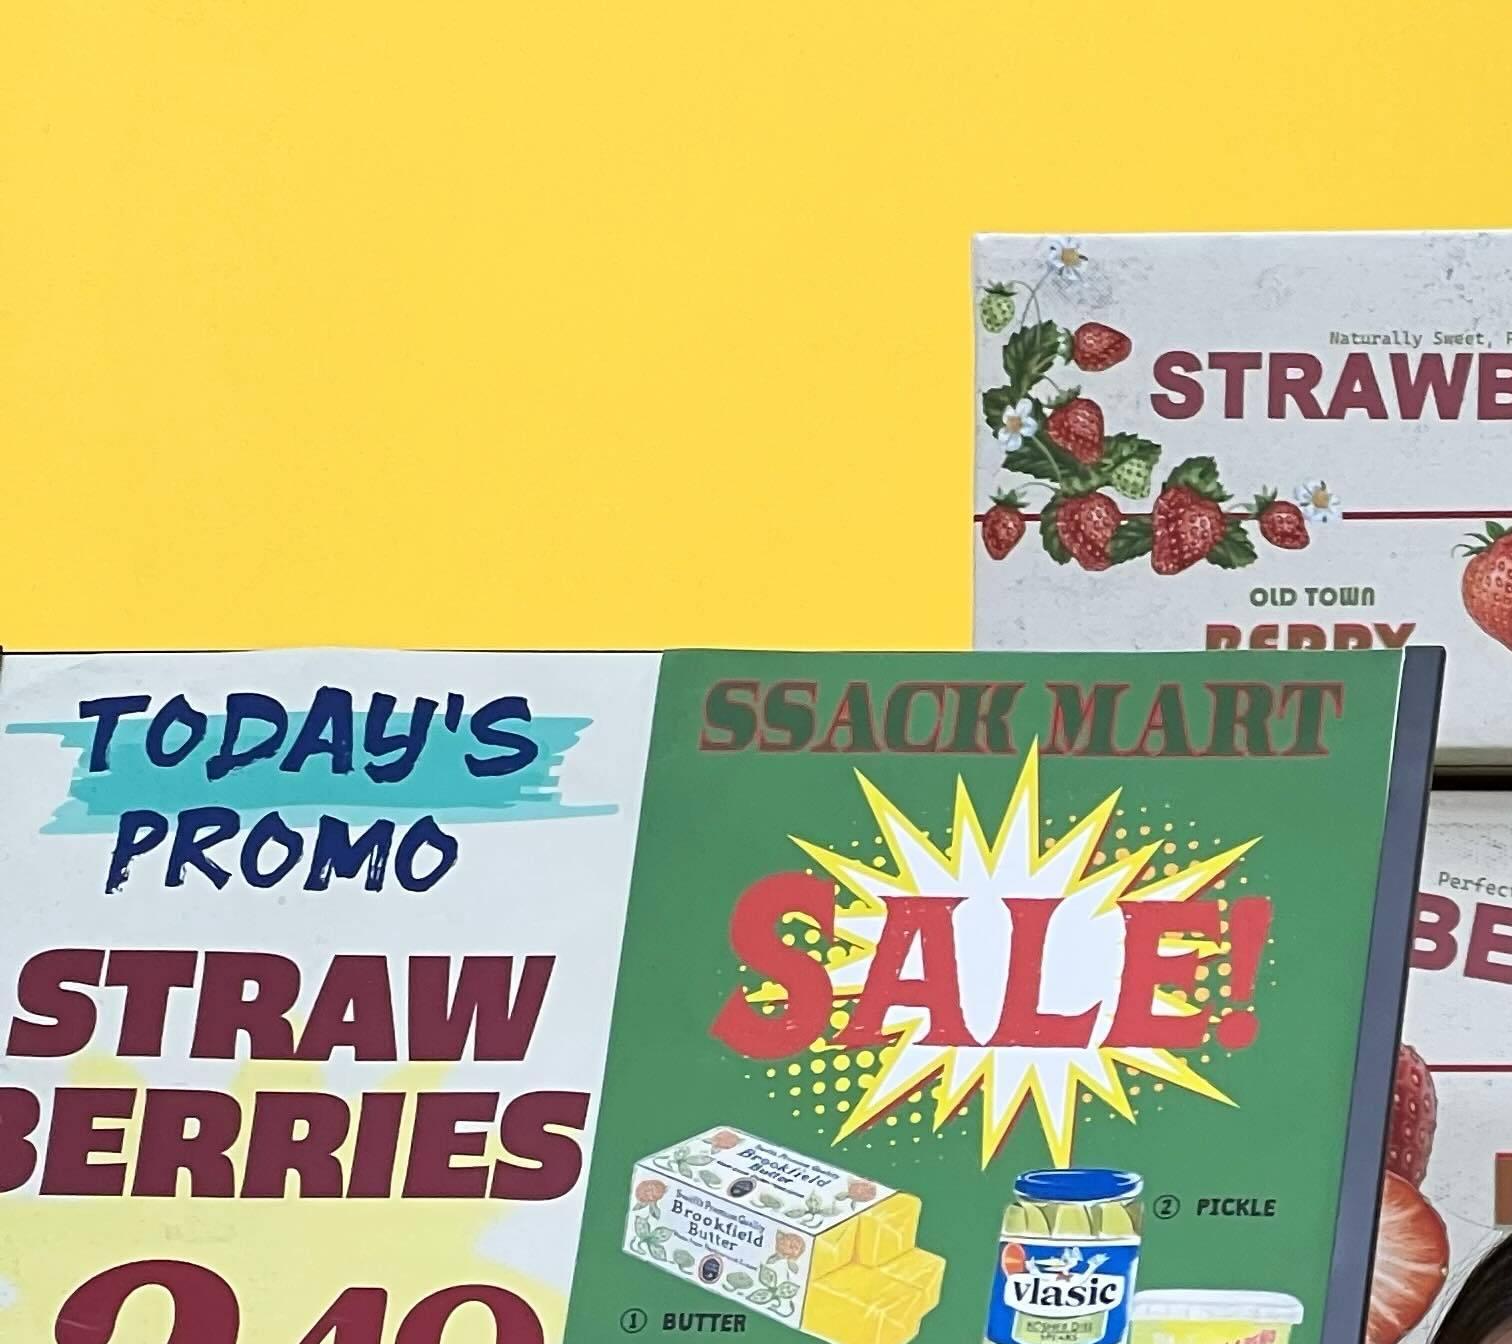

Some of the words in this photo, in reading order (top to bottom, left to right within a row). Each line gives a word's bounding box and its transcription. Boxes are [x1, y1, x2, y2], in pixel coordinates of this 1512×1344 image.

[1329, 330, 1423, 348] Naturally
[1433, 331, 1493, 348] Sweet,
[1250, 587, 1297, 607] OLD
[1305, 587, 1375, 607] TOWN
[80, 686, 539, 784] TODAY'S
[699, 680, 1026, 756] SSACK
[1038, 681, 1345, 758] MART
[106, 806, 458, 894] PROMO
[709, 870, 1274, 1061] SALE!
[6, 948, 556, 1062] STRAW
[671, 1199, 764, 1247] Brookfield
[1196, 1198, 1277, 1217] PICKLE
[688, 1222, 738, 1251] Butter
[1014, 1278, 1117, 1307] vlasic
[662, 1312, 746, 1334] BUTTER
